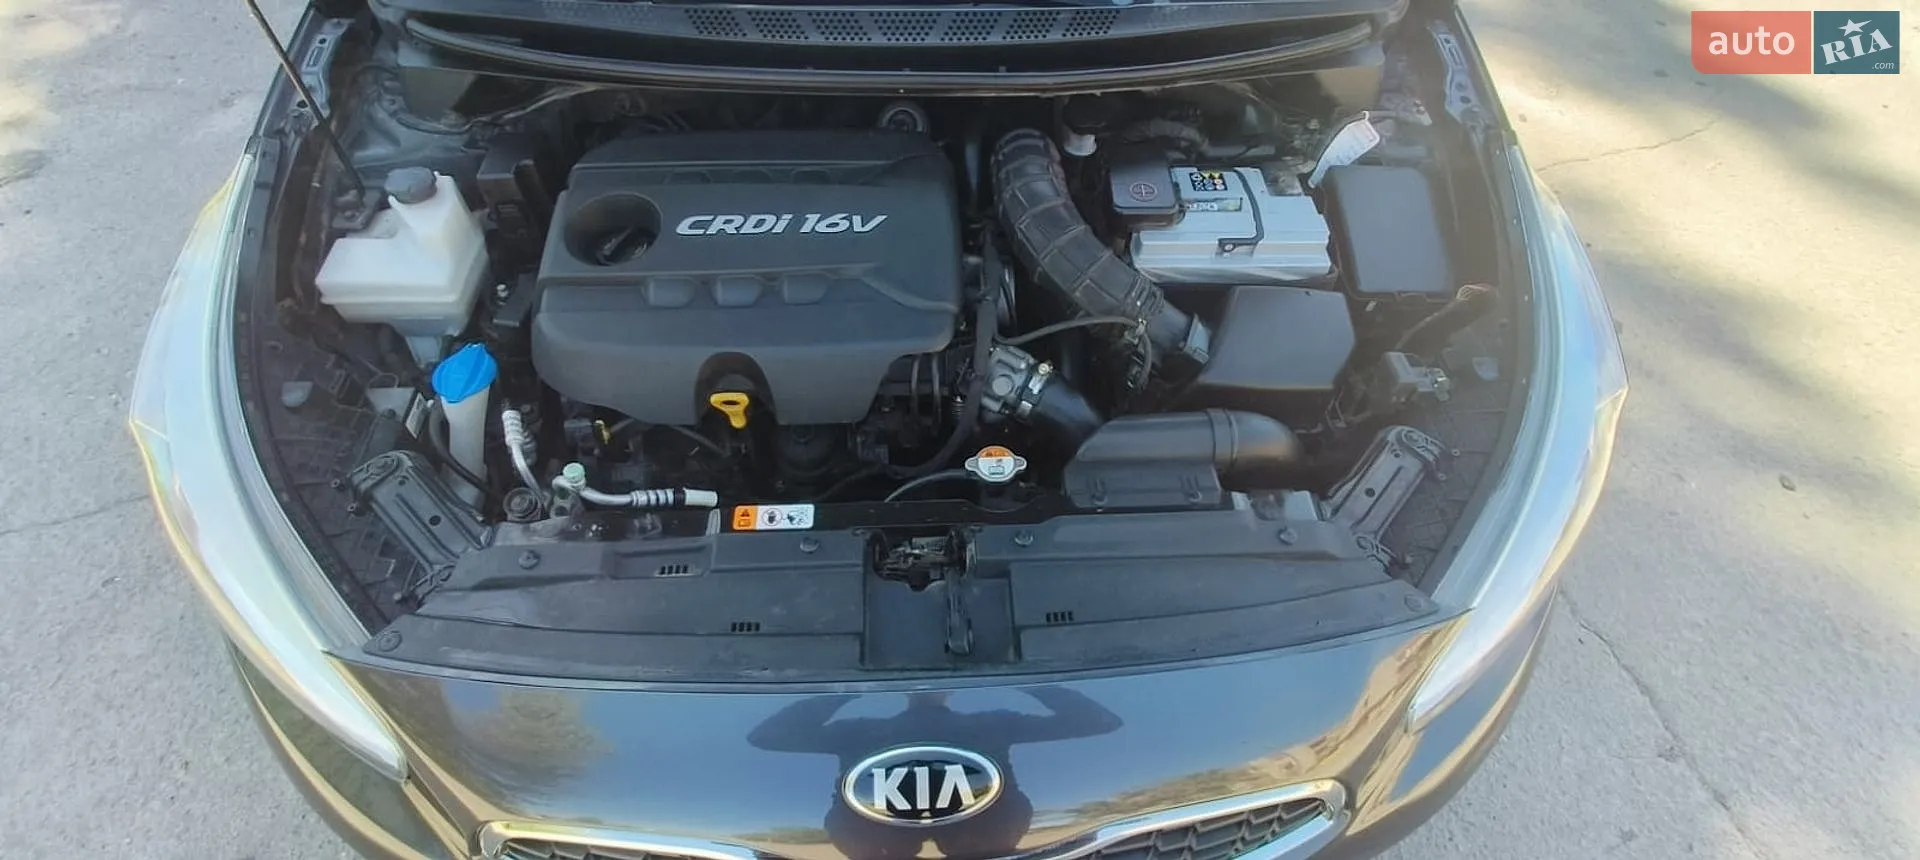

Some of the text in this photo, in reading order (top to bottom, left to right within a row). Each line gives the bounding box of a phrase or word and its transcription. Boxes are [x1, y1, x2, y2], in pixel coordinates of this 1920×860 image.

[675, 212, 889, 236] CRDi 16V
[871, 764, 976, 811] KIA
